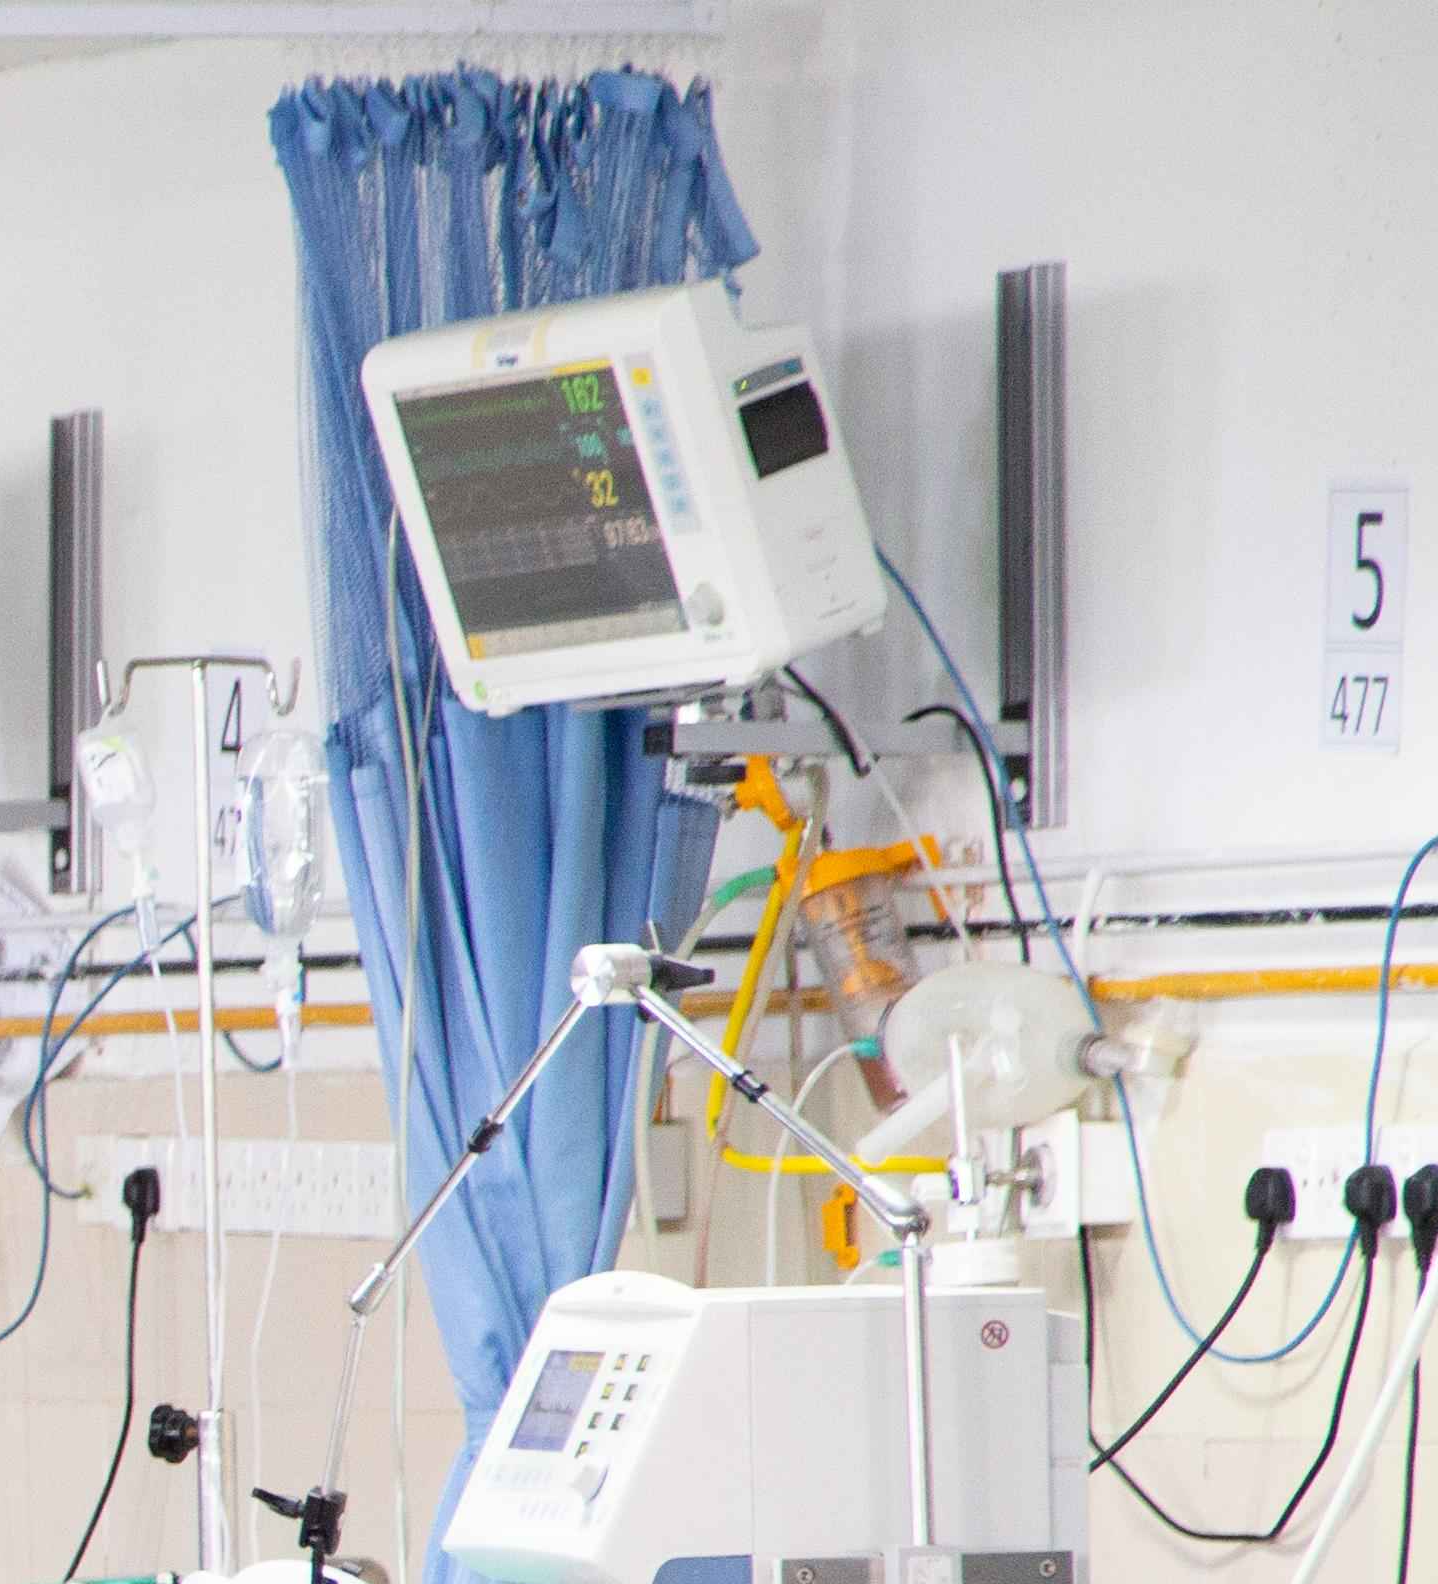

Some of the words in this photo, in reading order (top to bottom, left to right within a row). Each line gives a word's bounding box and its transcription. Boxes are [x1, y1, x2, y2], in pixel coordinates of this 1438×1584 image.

[582, 469, 619, 508] 32
[1351, 511, 1384, 630] 5
[222, 676, 243, 753] 4
[1330, 674, 1389, 736] 477
